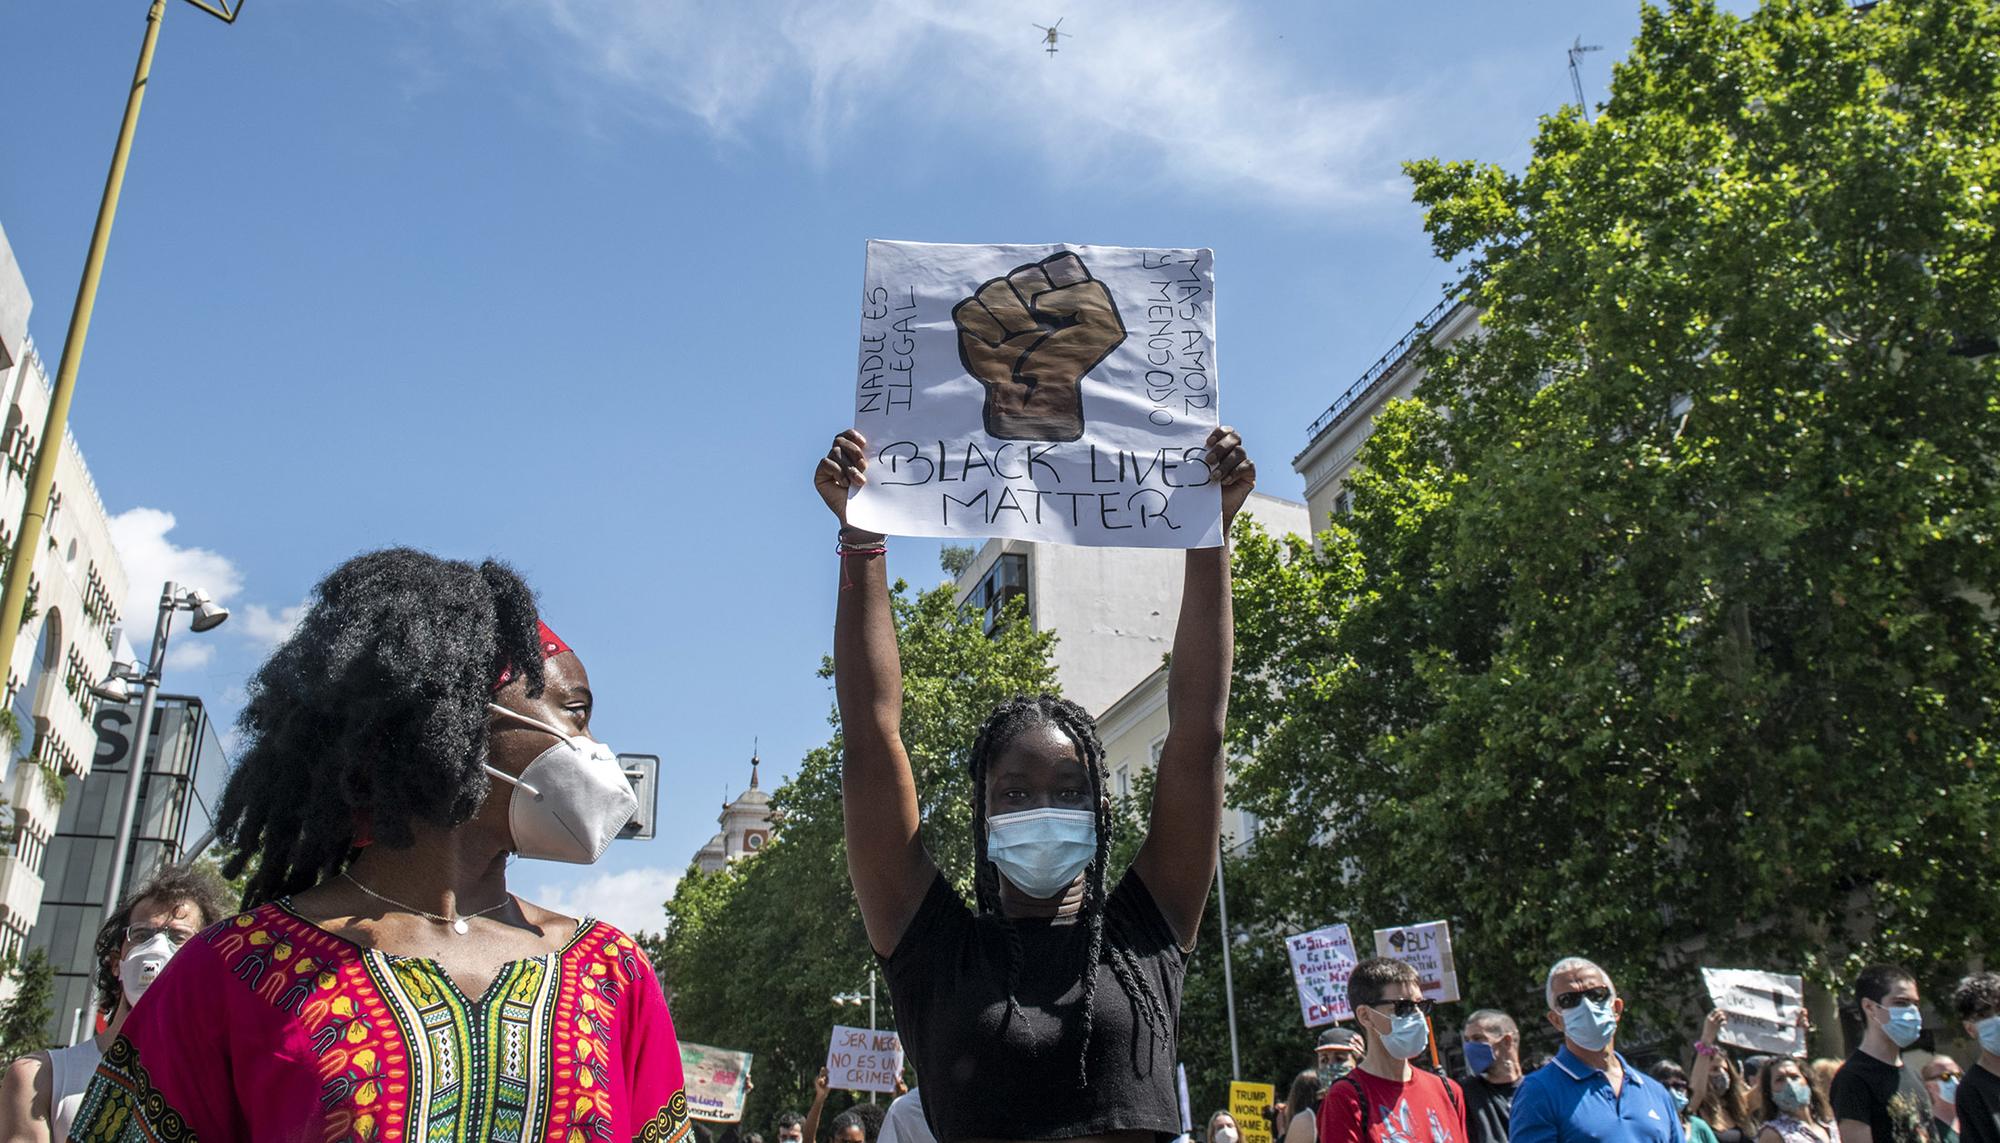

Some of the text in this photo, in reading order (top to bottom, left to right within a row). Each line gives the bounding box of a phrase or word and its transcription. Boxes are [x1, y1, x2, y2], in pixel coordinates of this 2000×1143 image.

[864, 286, 888, 320] ES
[1147, 280, 1175, 367] MENOS
[1180, 330, 1210, 416] AMOR
[879, 440, 1213, 488] BLACK LIVES
[943, 486, 1182, 530] MATTER
[1406, 931, 1436, 952] BLM
[840, 1030, 902, 1053] SER NEGR
[831, 1053, 899, 1071] NO ES UN
[1235, 1103, 1262, 1116] WORL
